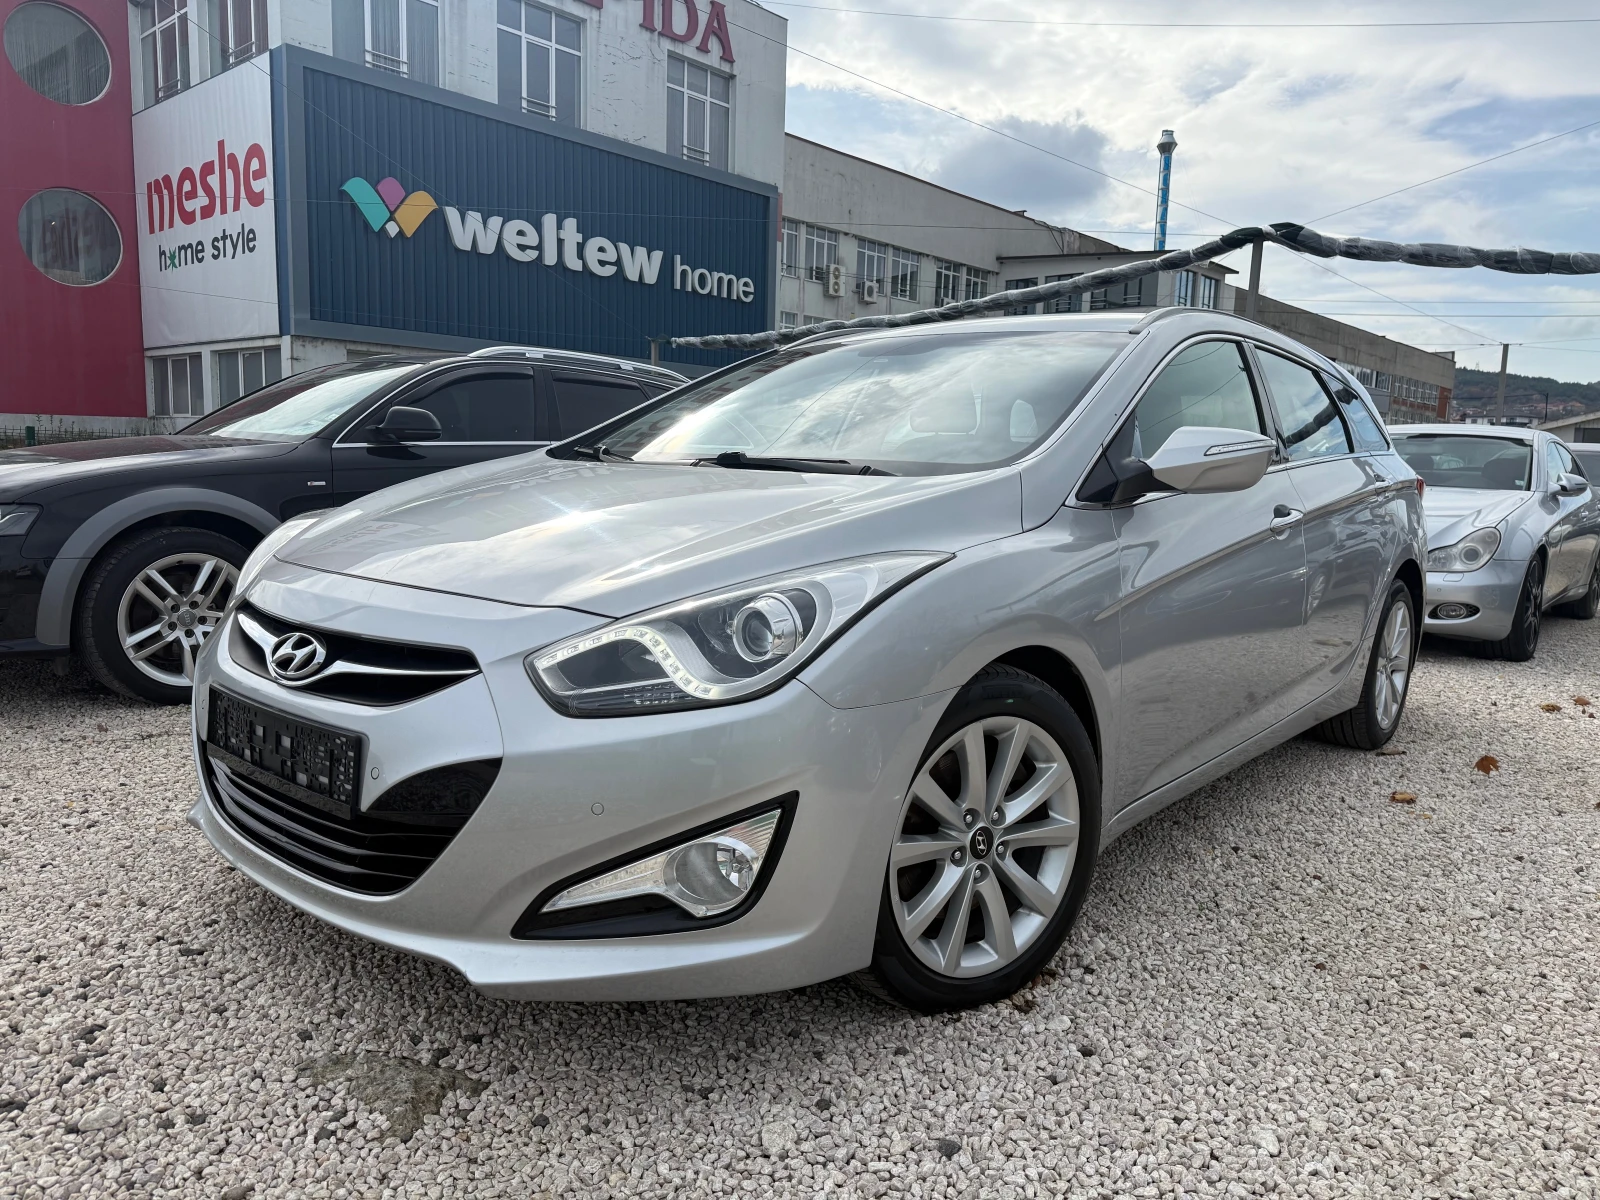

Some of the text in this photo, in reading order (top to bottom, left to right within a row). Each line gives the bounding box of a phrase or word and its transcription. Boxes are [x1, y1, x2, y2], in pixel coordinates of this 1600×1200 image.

[147, 139, 267, 235] meshe
[211, 222, 257, 260] style
[443, 206, 755, 303] weltew home
